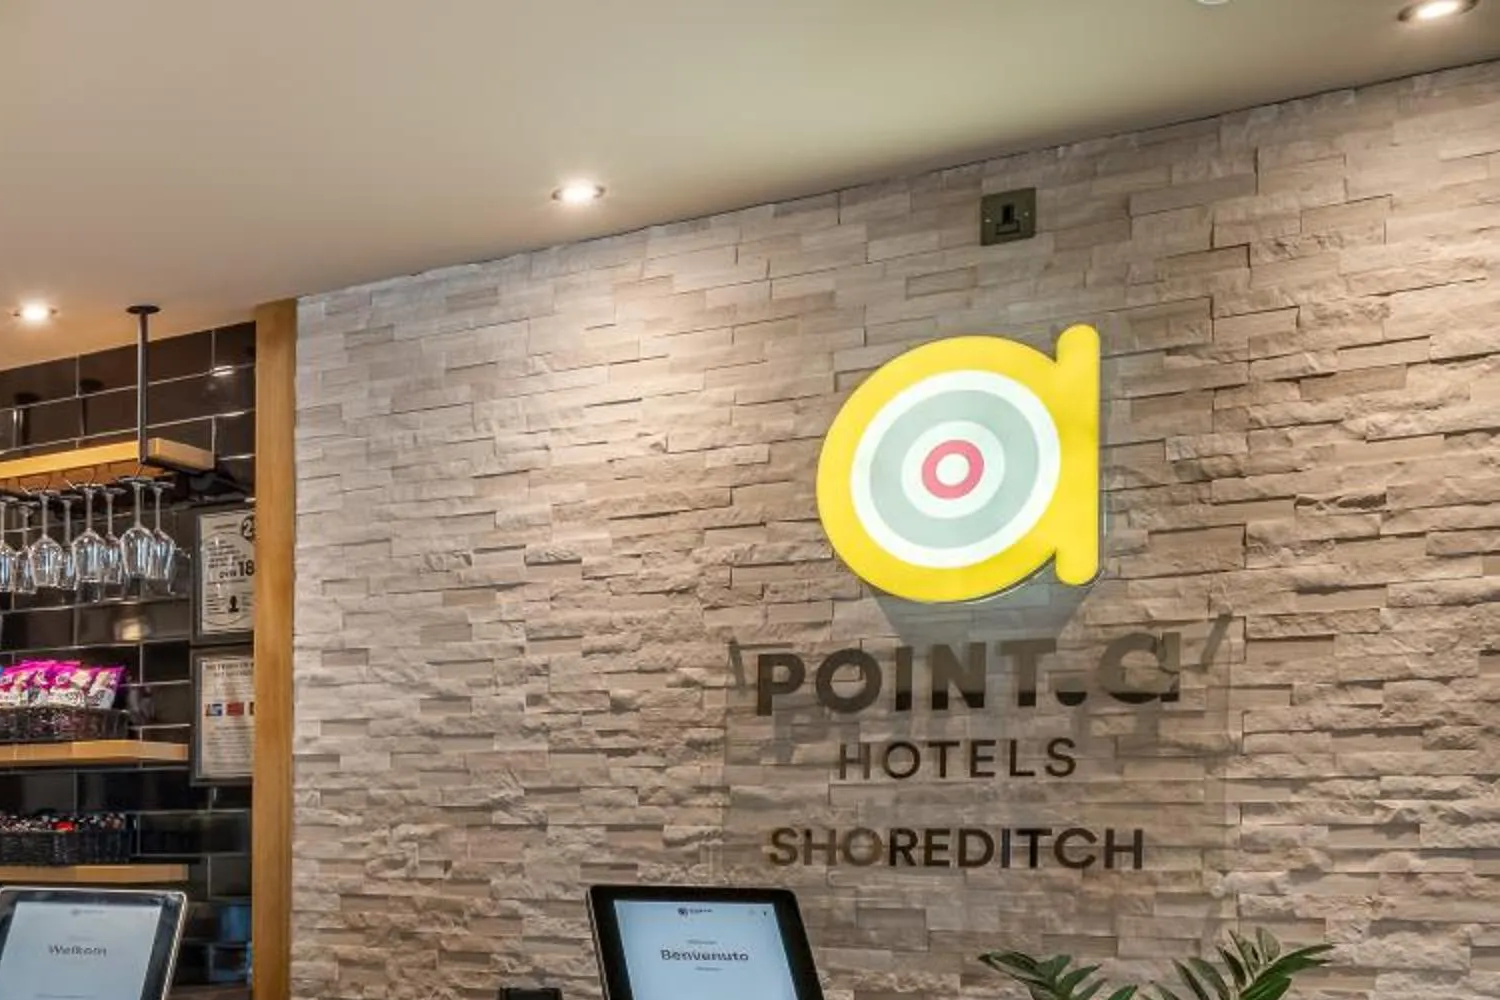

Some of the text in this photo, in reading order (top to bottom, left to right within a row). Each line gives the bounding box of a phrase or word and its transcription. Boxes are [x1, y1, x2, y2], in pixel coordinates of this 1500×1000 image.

[238, 560, 255, 577] 18
[838, 737, 1077, 780] HOTELS
[768, 826, 1144, 870] SHOREDITCH
[660, 949, 749, 962] Benvenuto
